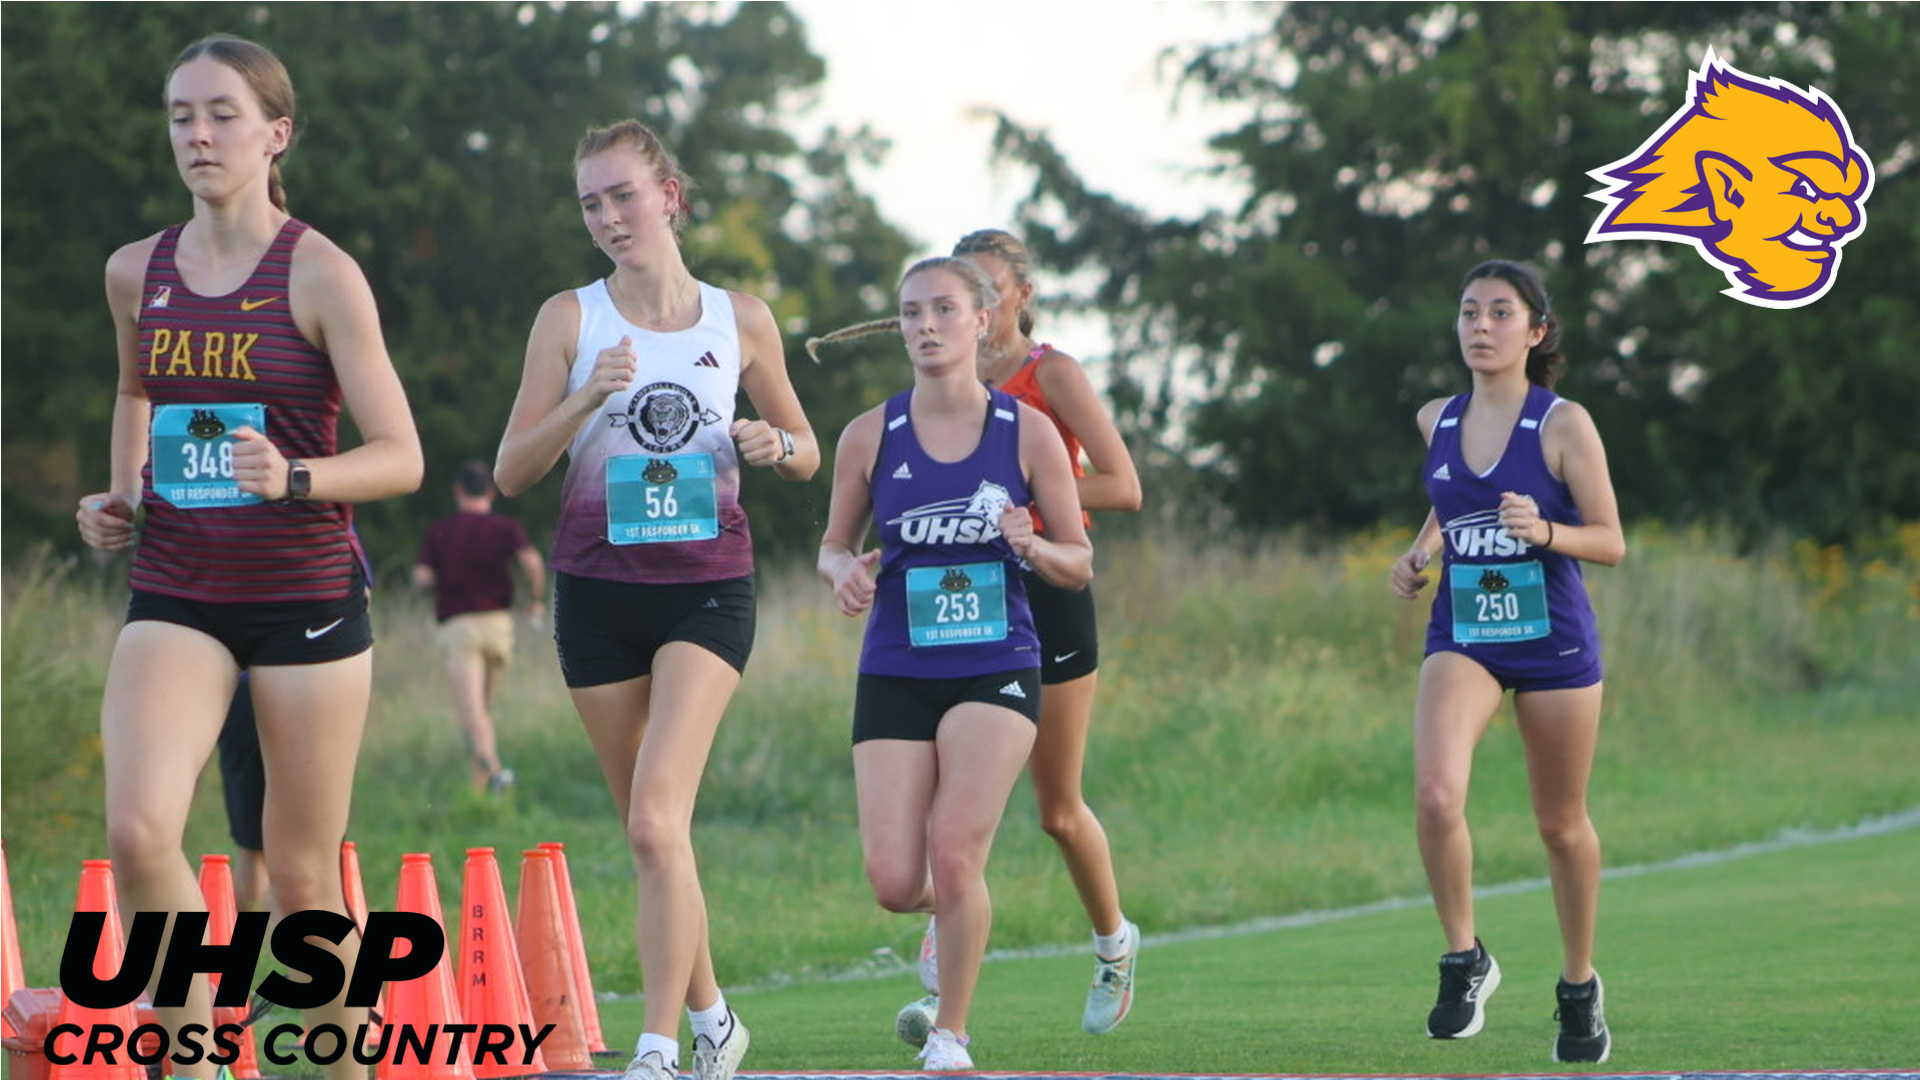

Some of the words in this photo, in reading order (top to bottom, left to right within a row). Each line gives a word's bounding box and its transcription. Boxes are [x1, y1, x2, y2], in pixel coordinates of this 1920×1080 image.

[148, 329, 258, 381] PARK
[181, 441, 234, 480] 348
[187, 487, 239, 500] RESPONDER
[645, 486, 678, 519] 56
[935, 592, 980, 623] 253
[1475, 593, 1519, 621] 250
[1481, 624, 1522, 637] RESPONDER
